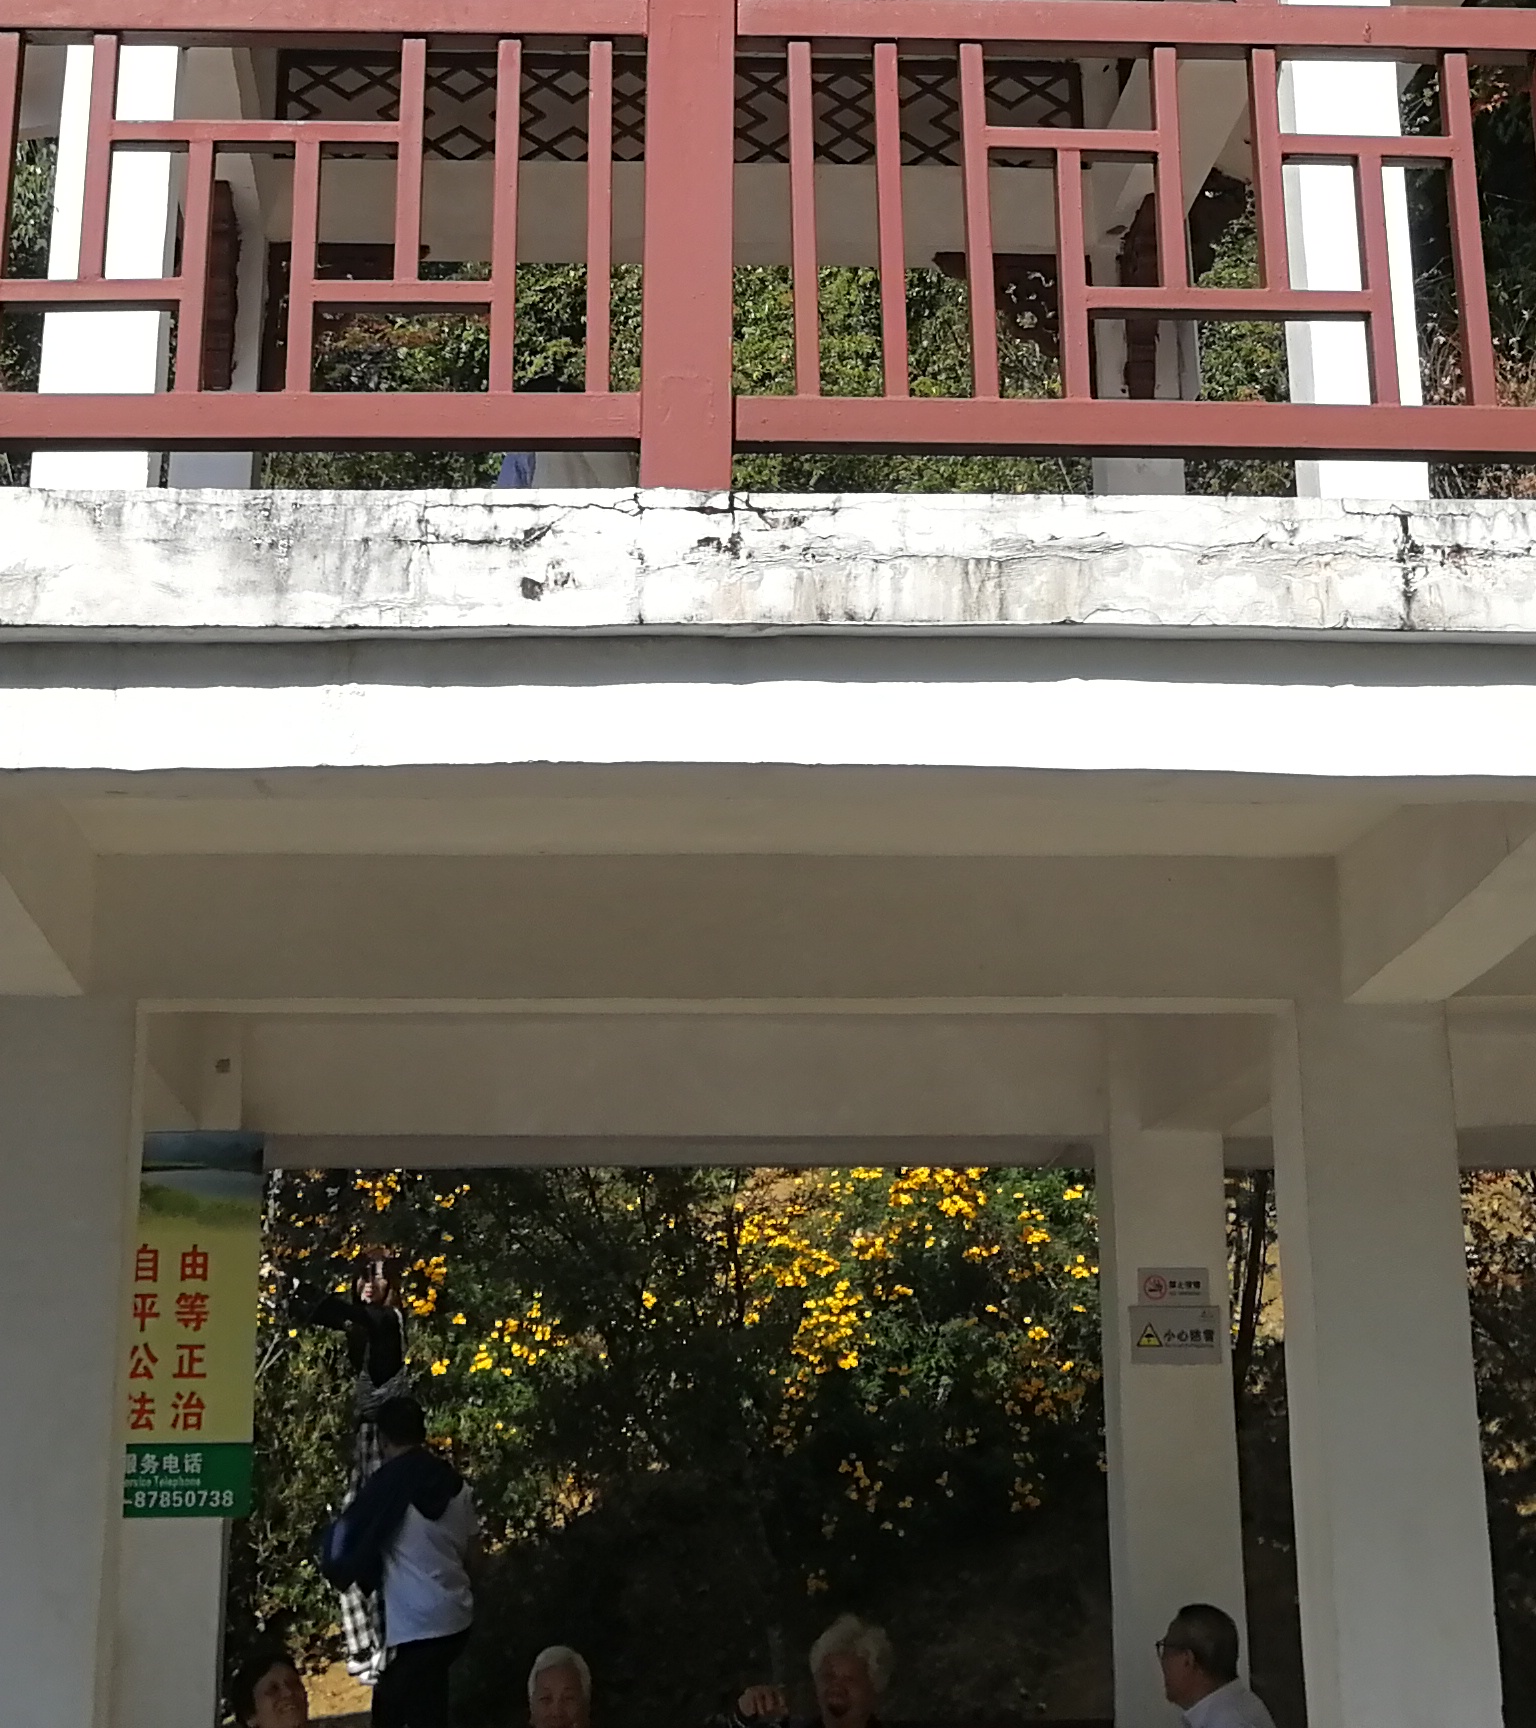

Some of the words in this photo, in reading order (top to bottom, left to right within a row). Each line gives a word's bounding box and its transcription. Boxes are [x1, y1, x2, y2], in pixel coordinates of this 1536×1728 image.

[134, 1243, 209, 1283] 自由
[133, 1292, 210, 1332] 平等
[129, 1342, 207, 1380] 公正
[127, 1391, 205, 1431] 法治
